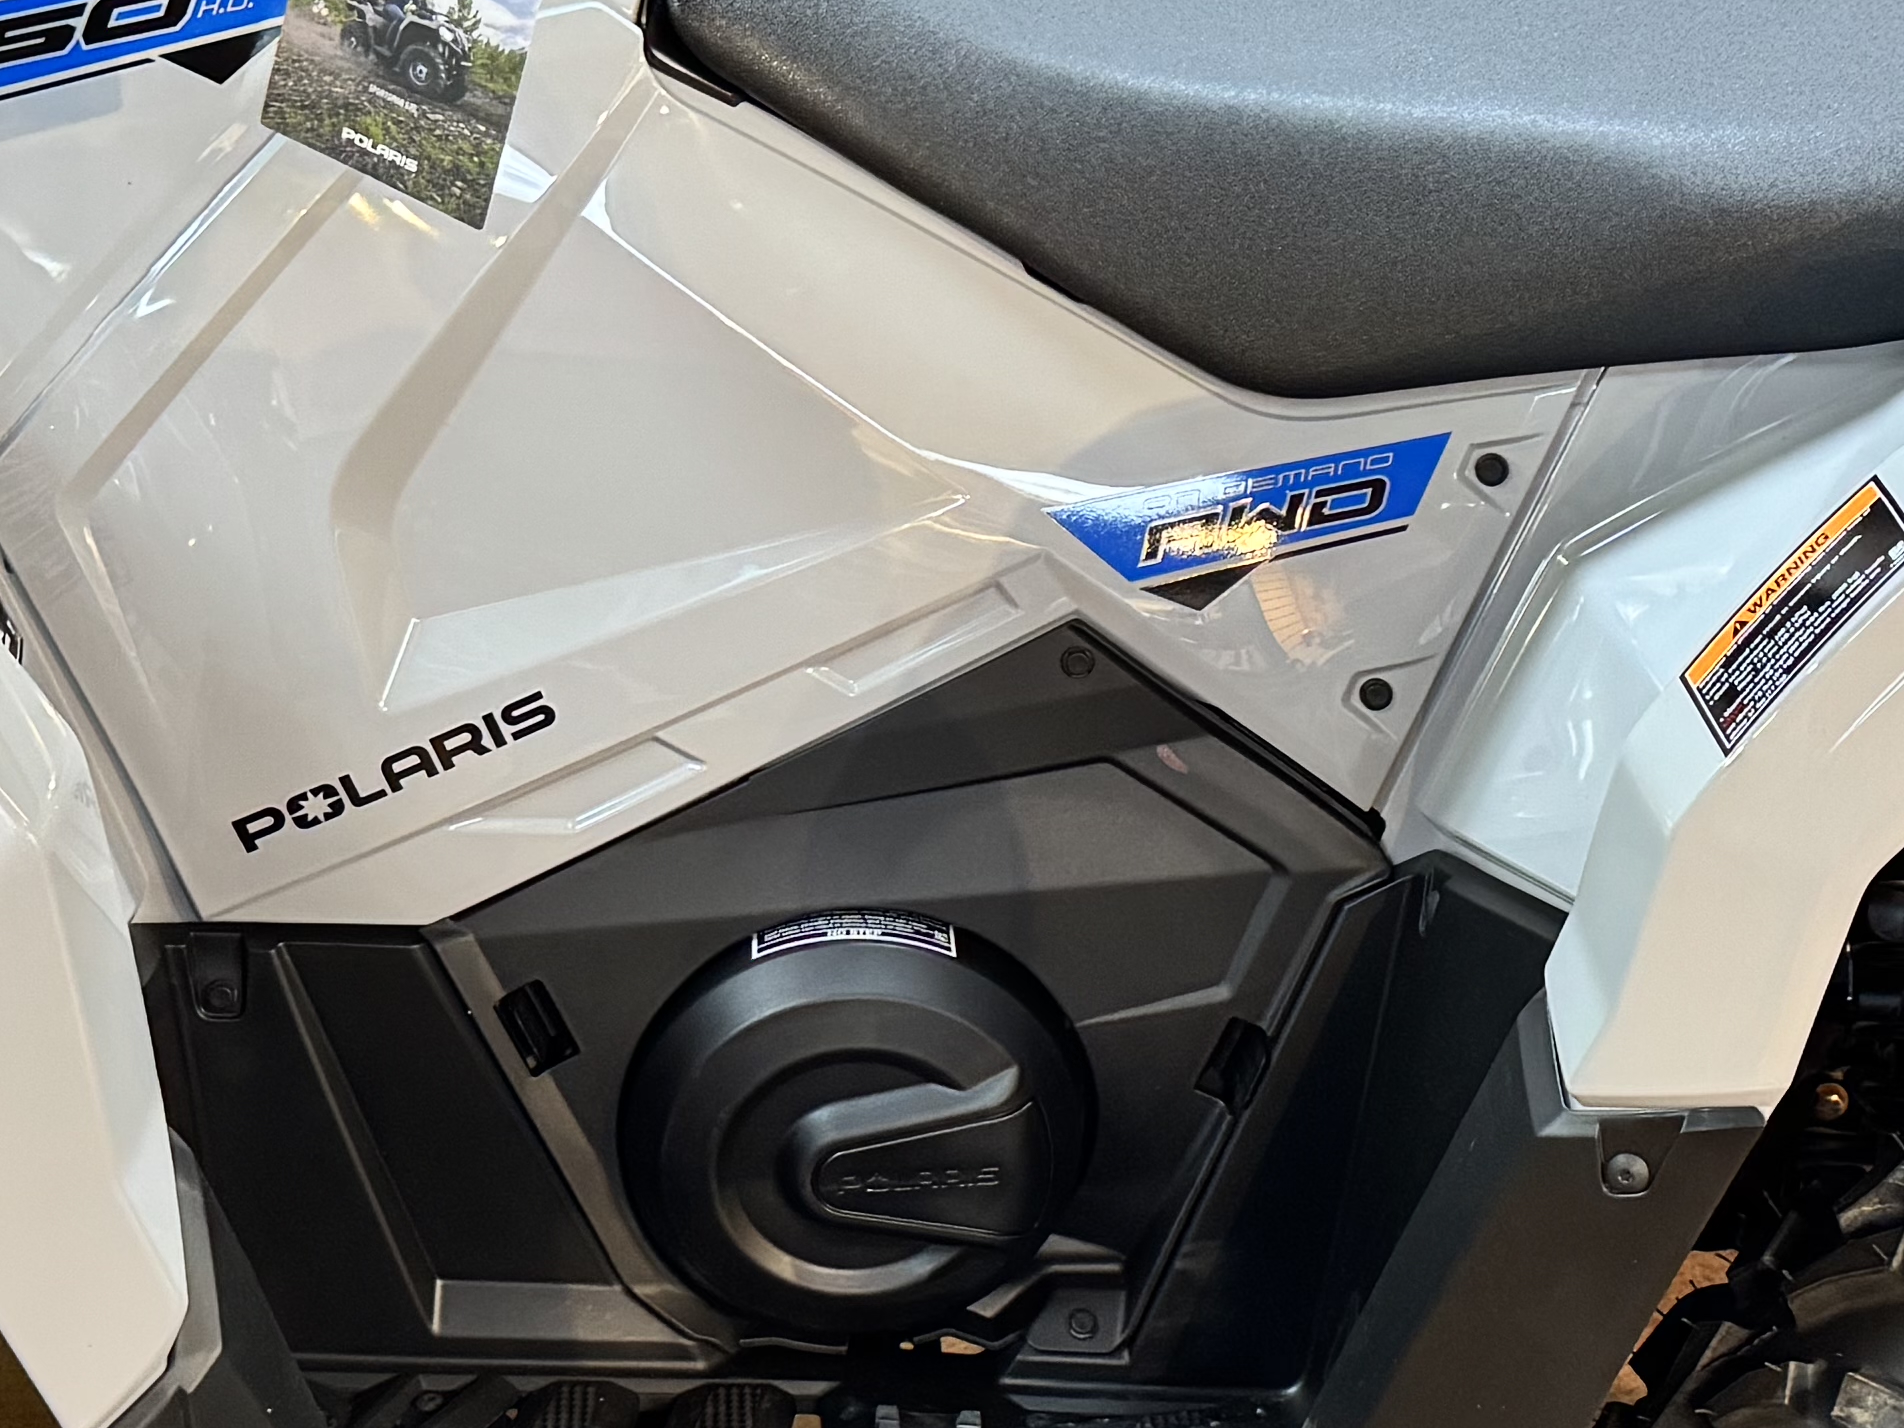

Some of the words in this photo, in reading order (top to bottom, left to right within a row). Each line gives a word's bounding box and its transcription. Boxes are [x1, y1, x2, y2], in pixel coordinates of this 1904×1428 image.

[341, 126, 418, 173] POLARIS
[1222, 451, 1395, 500] DEMAND
[1745, 531, 1832, 615] WARNING
[231, 690, 557, 854] POLARIS
